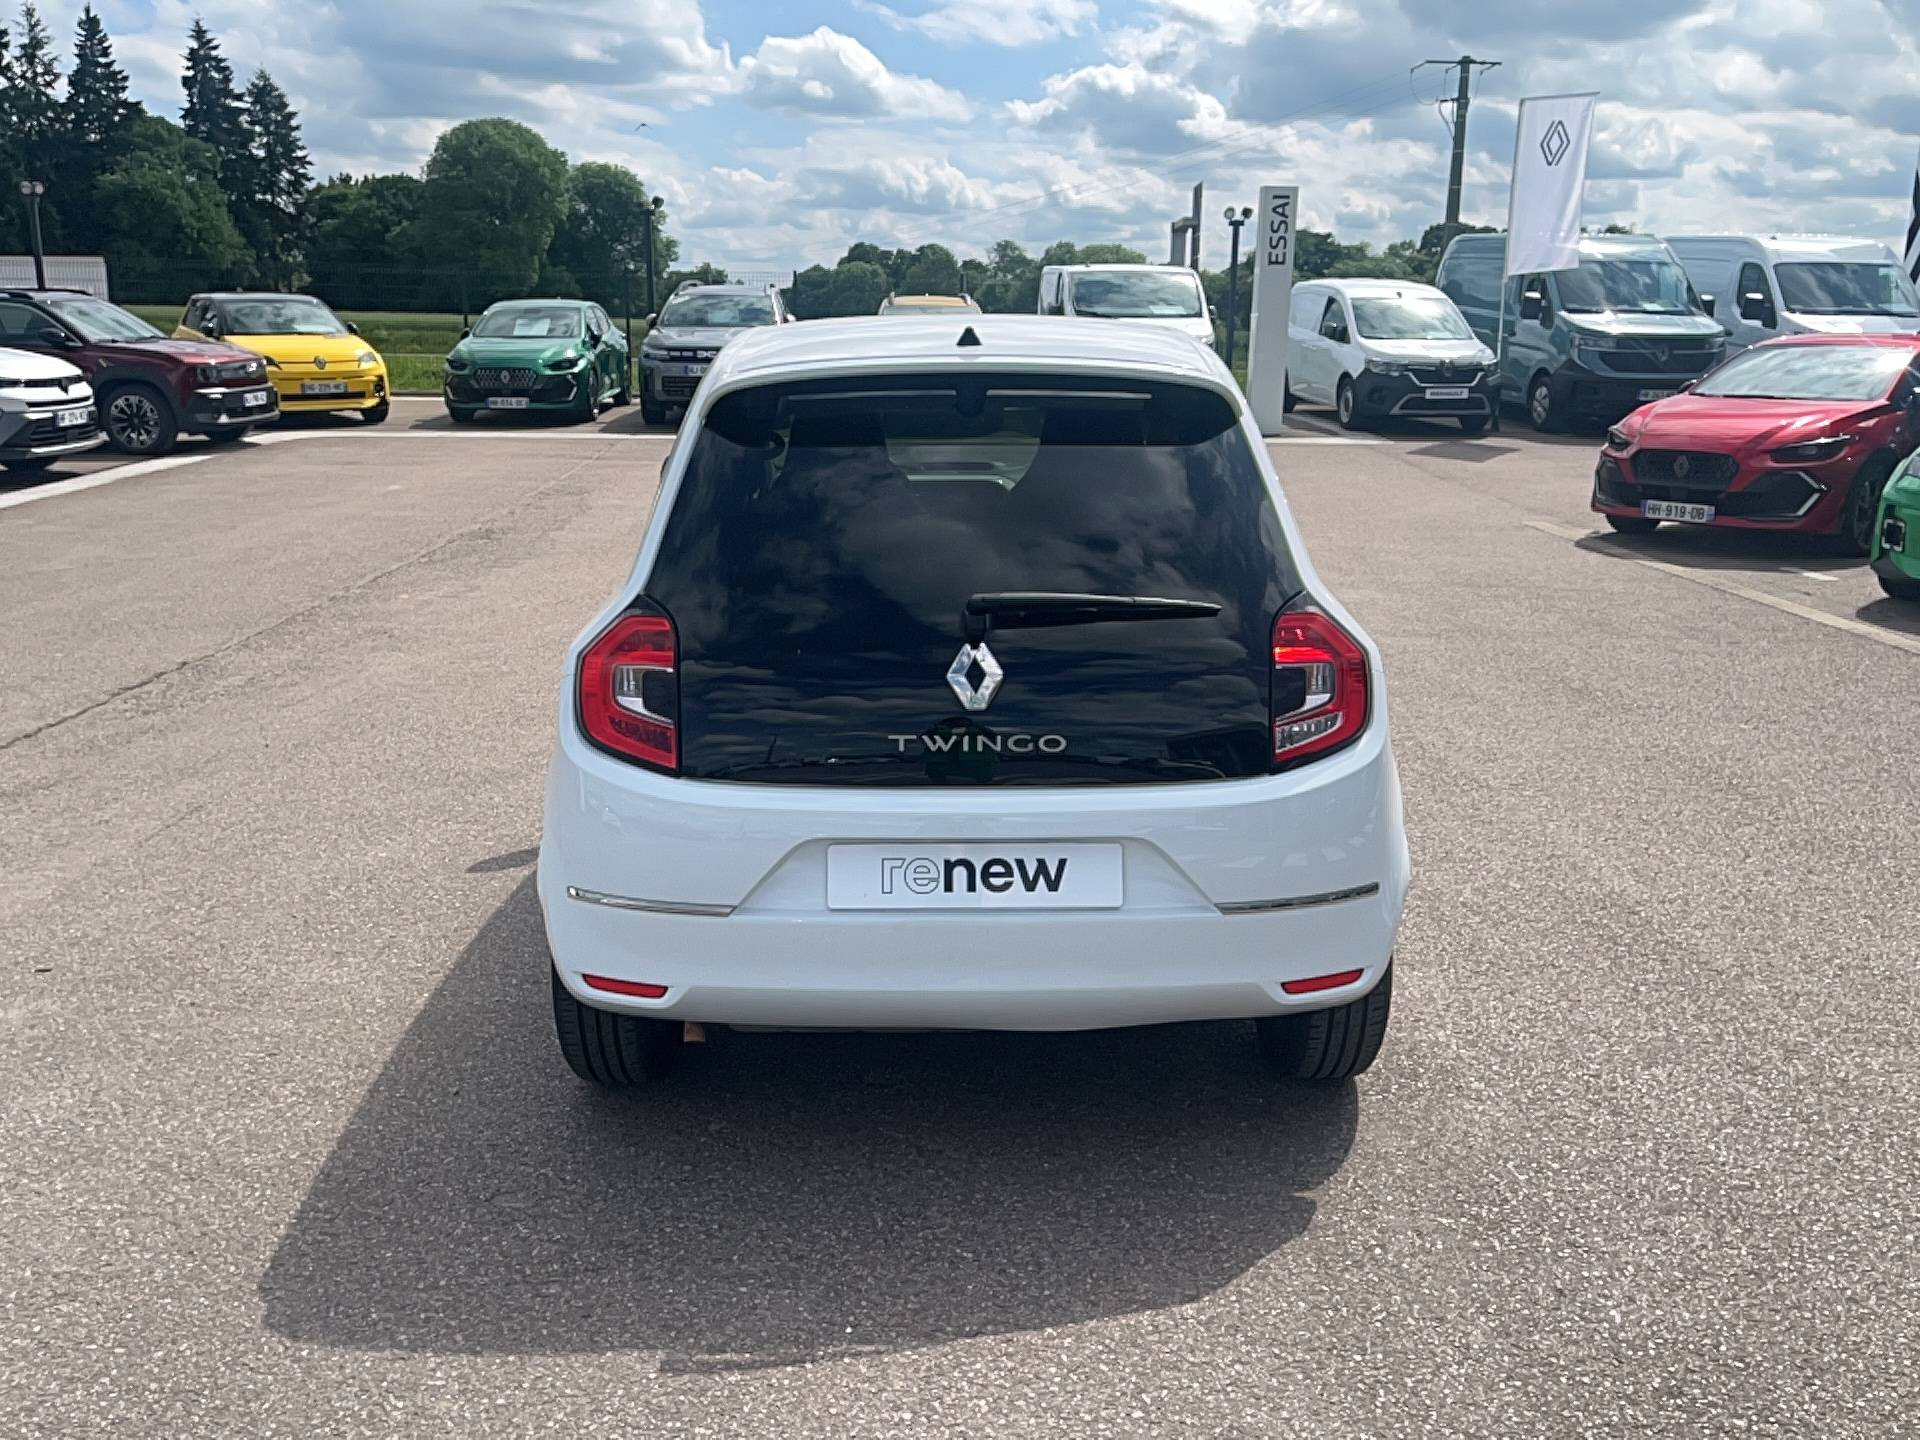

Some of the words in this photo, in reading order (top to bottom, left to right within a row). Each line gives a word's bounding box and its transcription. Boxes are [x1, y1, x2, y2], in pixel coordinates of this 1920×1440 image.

[1268, 194, 1290, 266] ESSAI
[1647, 503, 1705, 521] HH-919-DB
[887, 734, 1068, 753] TWINGO
[881, 857, 1068, 895] renew
